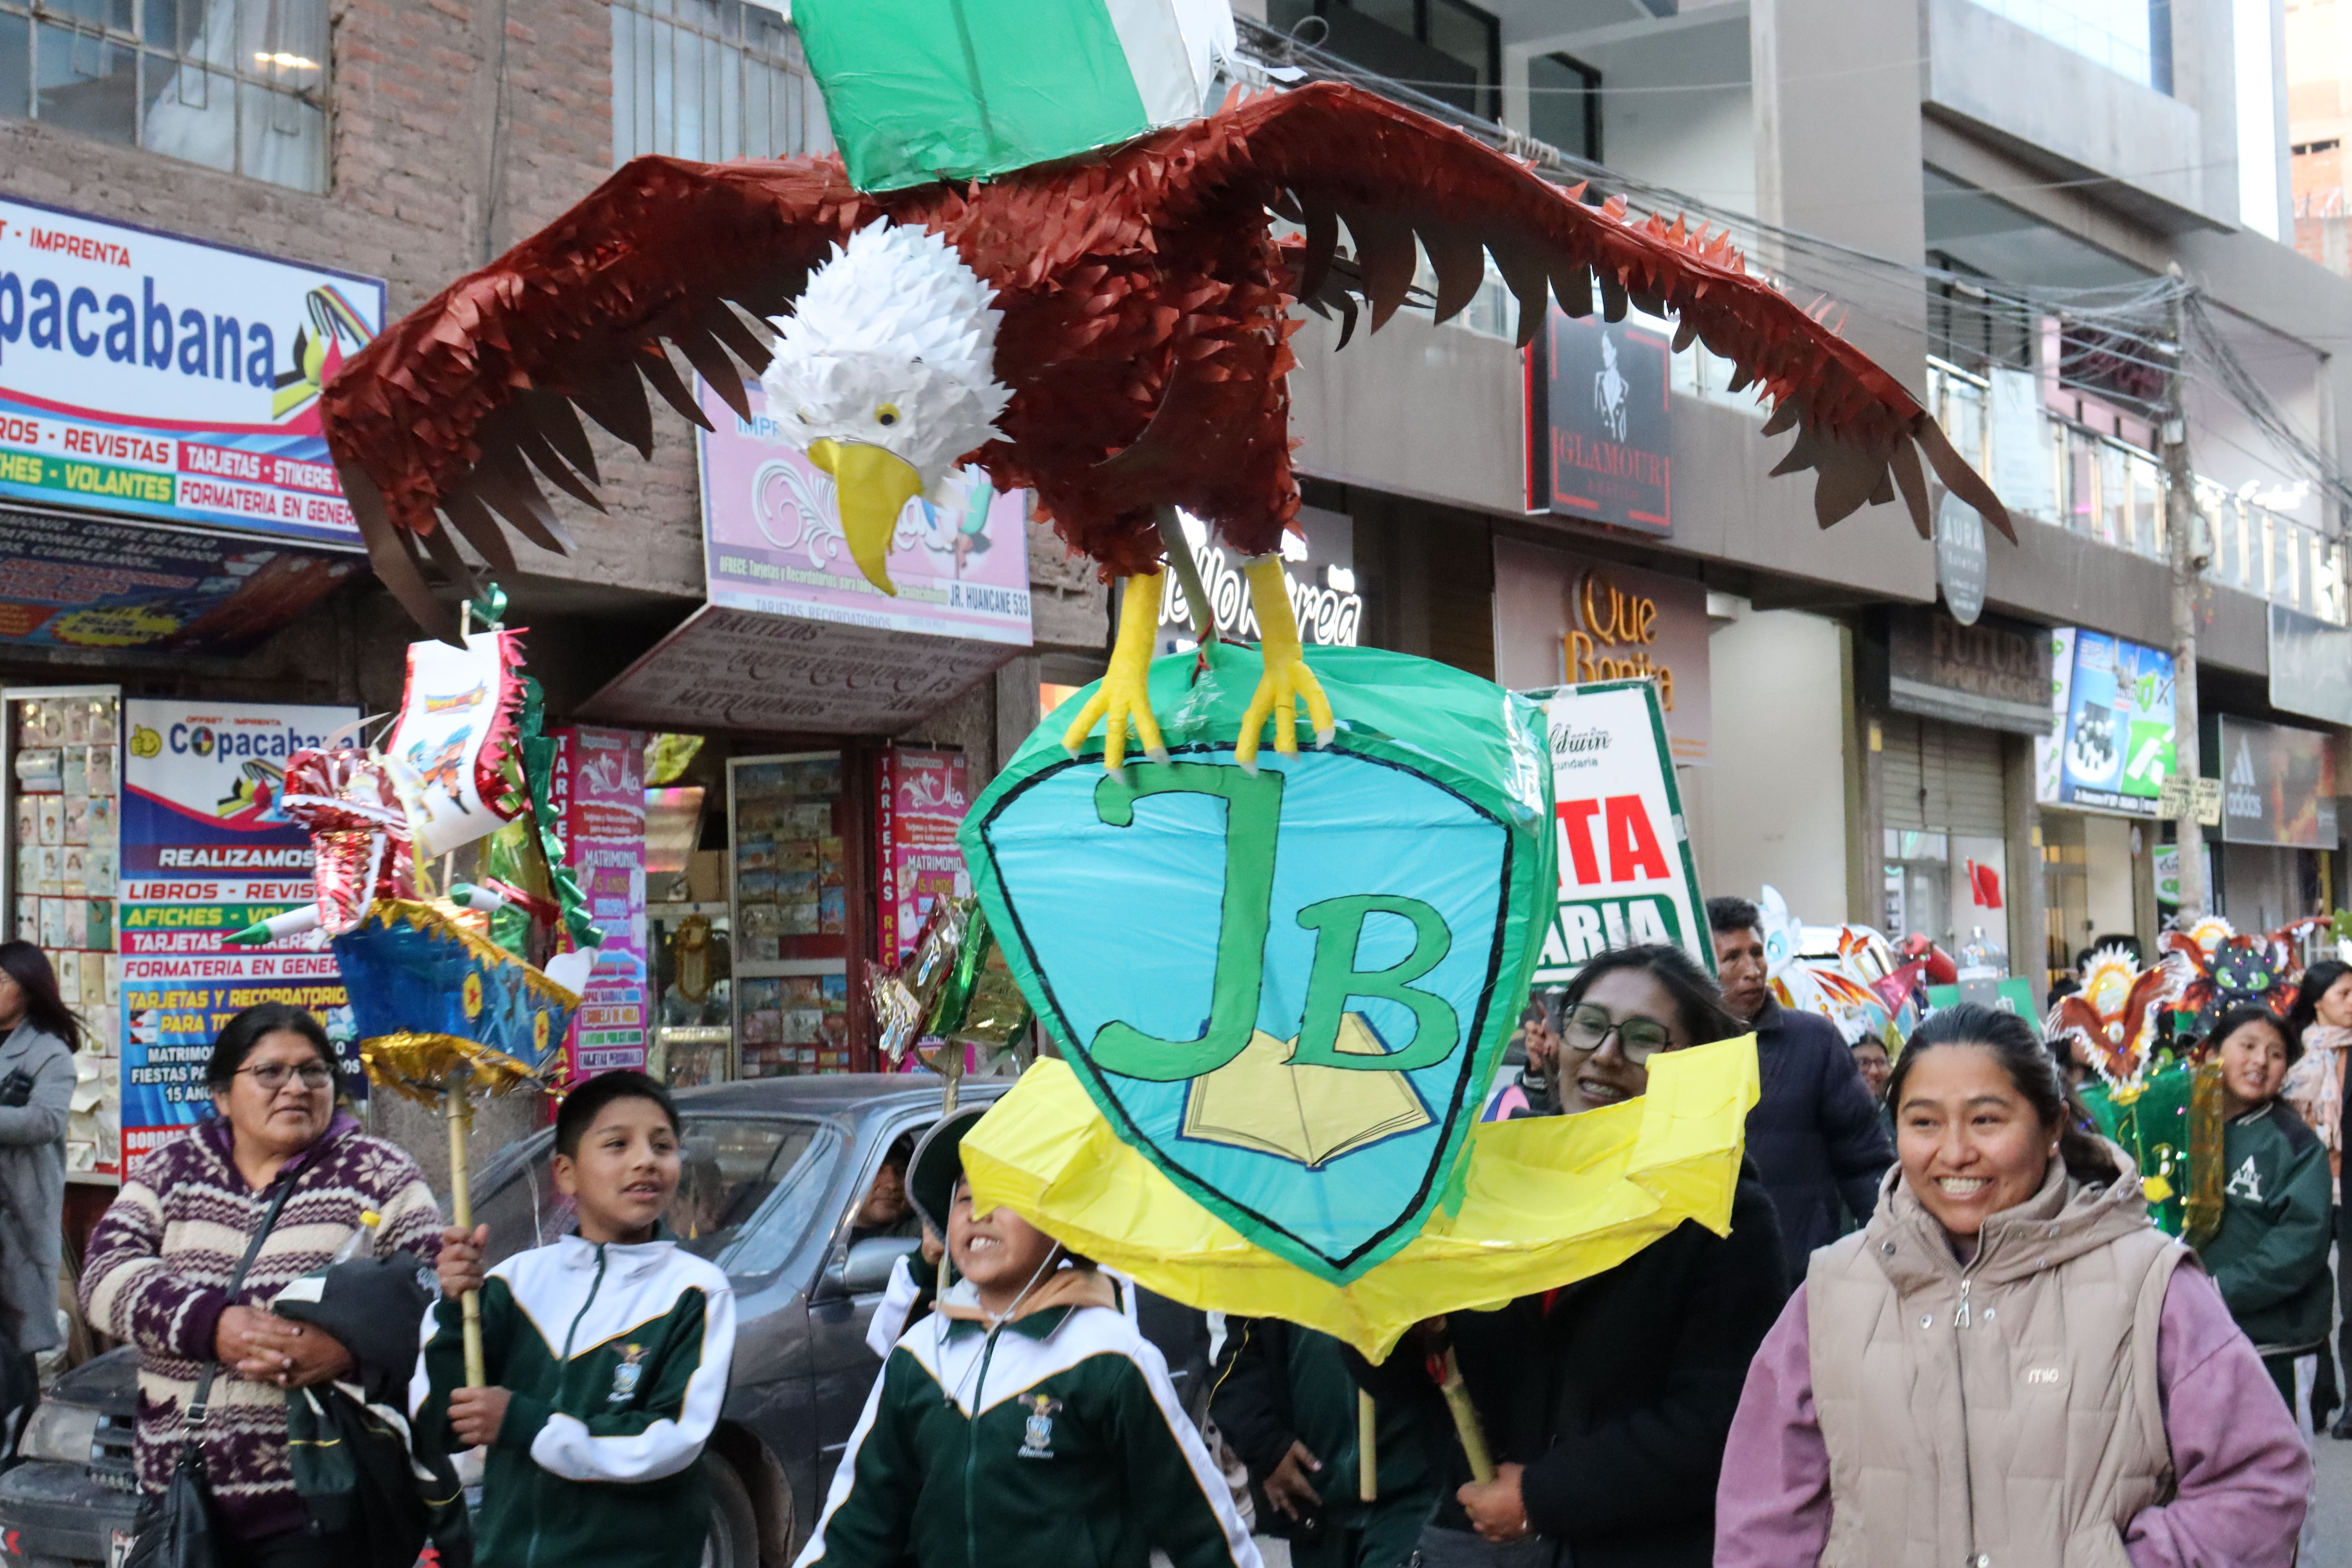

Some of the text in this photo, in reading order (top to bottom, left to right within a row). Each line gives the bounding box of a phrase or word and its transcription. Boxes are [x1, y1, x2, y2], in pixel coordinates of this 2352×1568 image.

[30, 227, 131, 268] IMPRENTA
[0, 270, 276, 390] pacabana
[0, 416, 169, 464] ROS REVISTAS
[738, 416, 780, 437] IMPR
[187, 446, 260, 479] TARJETAS
[1560, 430, 1661, 487] GLAMOUR
[0, 454, 171, 501] HES VOLANTES
[180, 480, 357, 527] FORMATERIA EN GENER
[1944, 514, 1982, 551] AURA
[749, 560, 779, 581] Tarjetas
[756, 599, 891, 629] TARJETAS RECORDATORIOS
[950, 584, 1029, 617] JR. HUANCANE 533
[1580, 568, 1657, 646] Que
[169, 722, 355, 763] Copacabaa
[1549, 723, 1612, 754] ldwin
[1552, 756, 1598, 771] cundaria
[2228, 791, 2263, 819] adidas
[881, 757, 893, 901] TARJETAS
[1556, 794, 1671, 888] TA
[158, 848, 315, 867] REALIZAMOS
[585, 849, 637, 869] MATRIMONIO
[907, 855, 962, 872] MATRIMONIO
[129, 883, 314, 899] LIBROS REVIS
[126, 907, 223, 926] AFICHES
[132, 933, 222, 951] TARJETAS
[1537, 897, 1670, 966] ARIA
[125, 958, 341, 977] FORMATERIA EN GENER
[127, 986, 349, 1010] TARJETAS Y RECORDATORIO
[160, 1013, 237, 1034] PARA TO
[148, 1045, 215, 1063] MATRIMO
[131, 1067, 187, 1084] FIESTAS
[166, 1086, 182, 1102] 15
